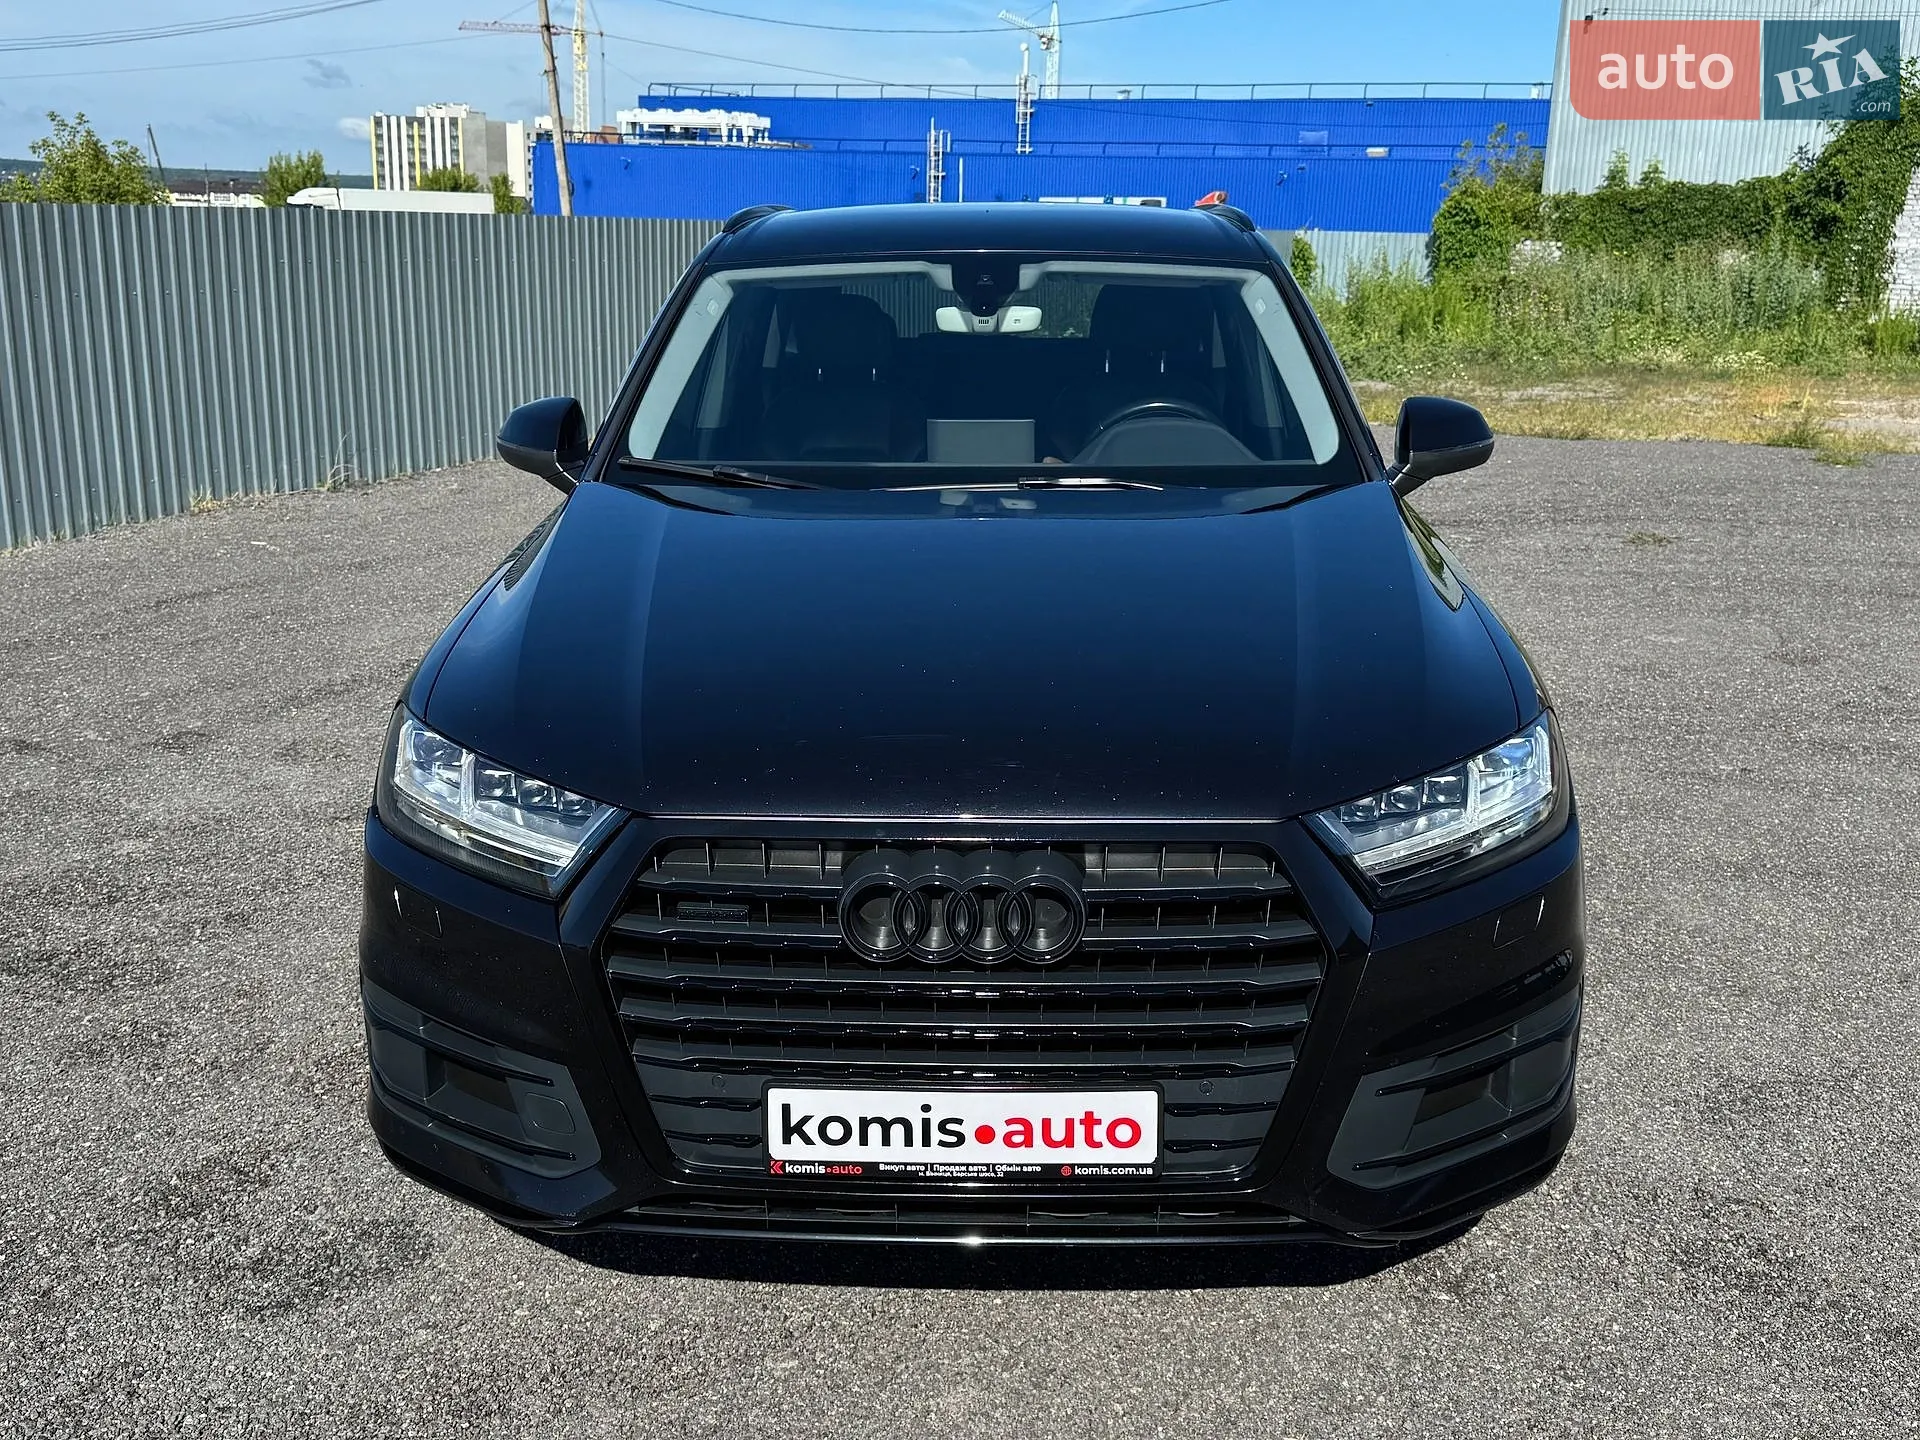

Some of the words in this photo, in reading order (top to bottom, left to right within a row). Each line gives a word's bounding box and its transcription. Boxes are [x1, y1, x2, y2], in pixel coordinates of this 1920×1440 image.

[879, 1163, 905, 1172] Викуп
[933, 1164, 967, 1173] Продаж
[1074, 1165, 1153, 1175] komis.com.ua
